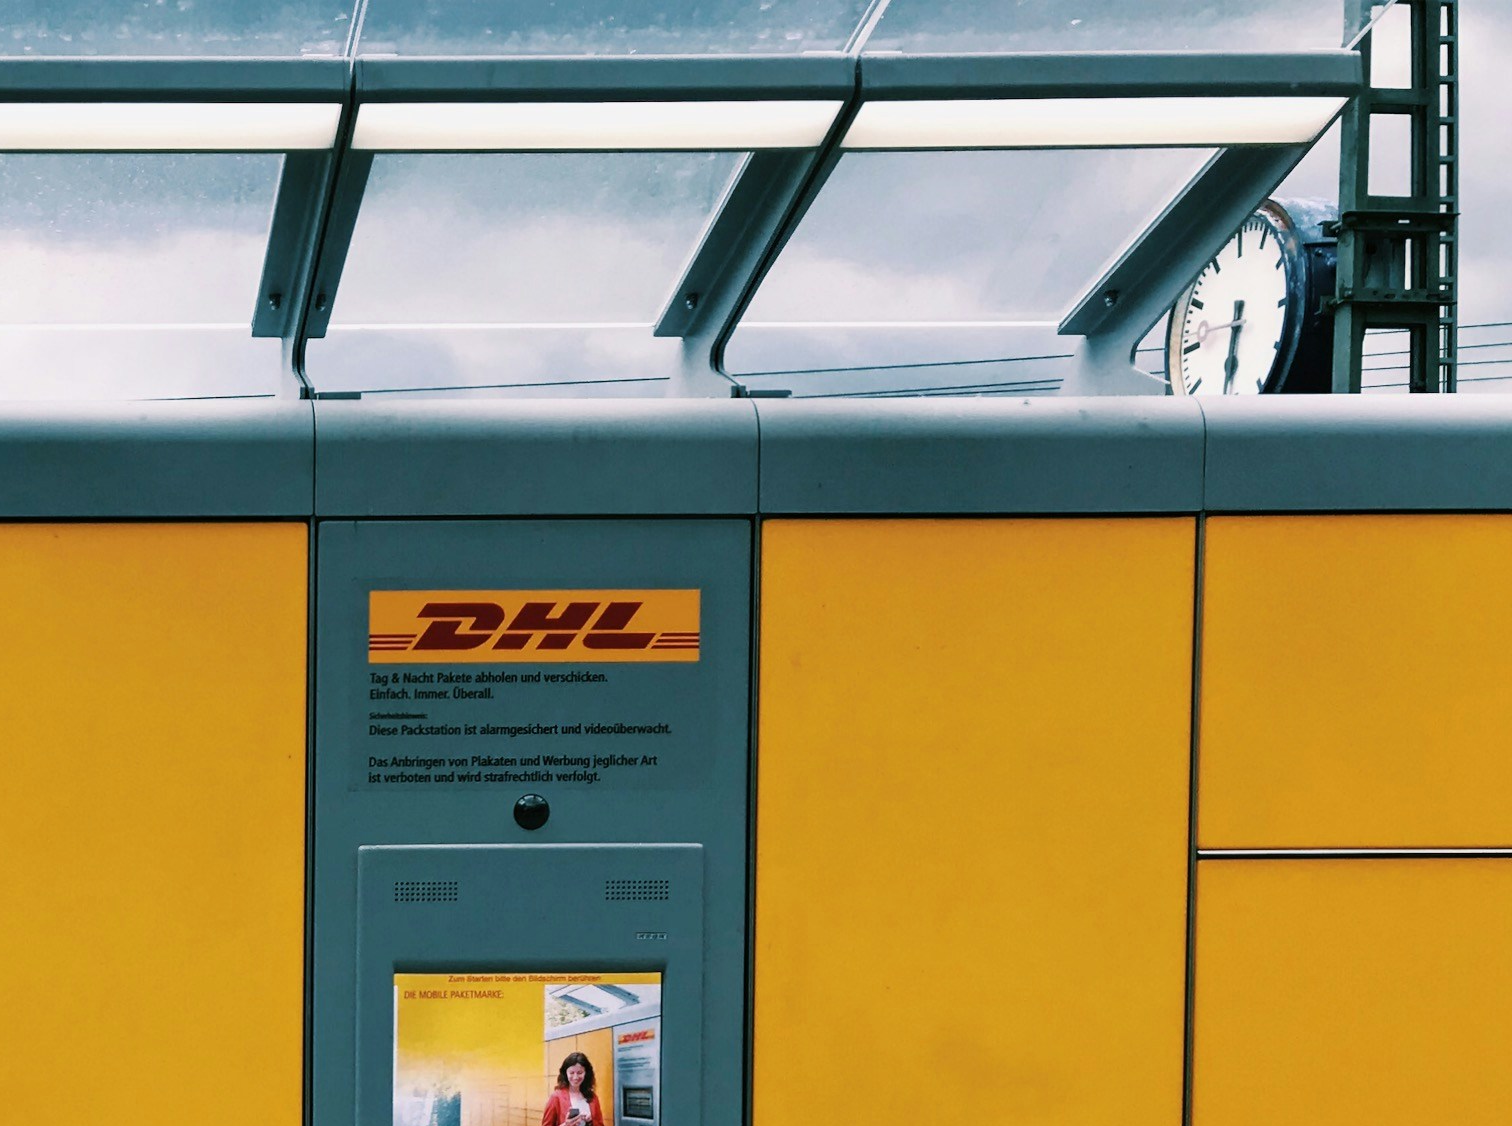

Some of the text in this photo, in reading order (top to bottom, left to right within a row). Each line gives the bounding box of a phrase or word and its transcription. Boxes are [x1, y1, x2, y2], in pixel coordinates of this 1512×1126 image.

[412, 601, 656, 650] DHL
[370, 671, 608, 686] Tag & Nacht Pakete abholen und verschicken.
[370, 686, 495, 700] Einfach. Immer. Überall.
[369, 722, 672, 738] Diese Packstation ist alarmgesichert und videoüberwacht.
[368, 754, 658, 770] Das Anbringen von Plakaten und Werbung jeglicher Art
[368, 769, 601, 785] ist verboten und wird strafrechtlich verfolgt.
[448, 975, 465, 983] Zum
[467, 975, 493, 983] Starten
[495, 975, 511, 983] bitte
[513, 975, 527, 983] den
[529, 975, 567, 983] Bildschirm
[403, 990, 417, 1000] DIE
[419, 990, 448, 1000] MOBILE
